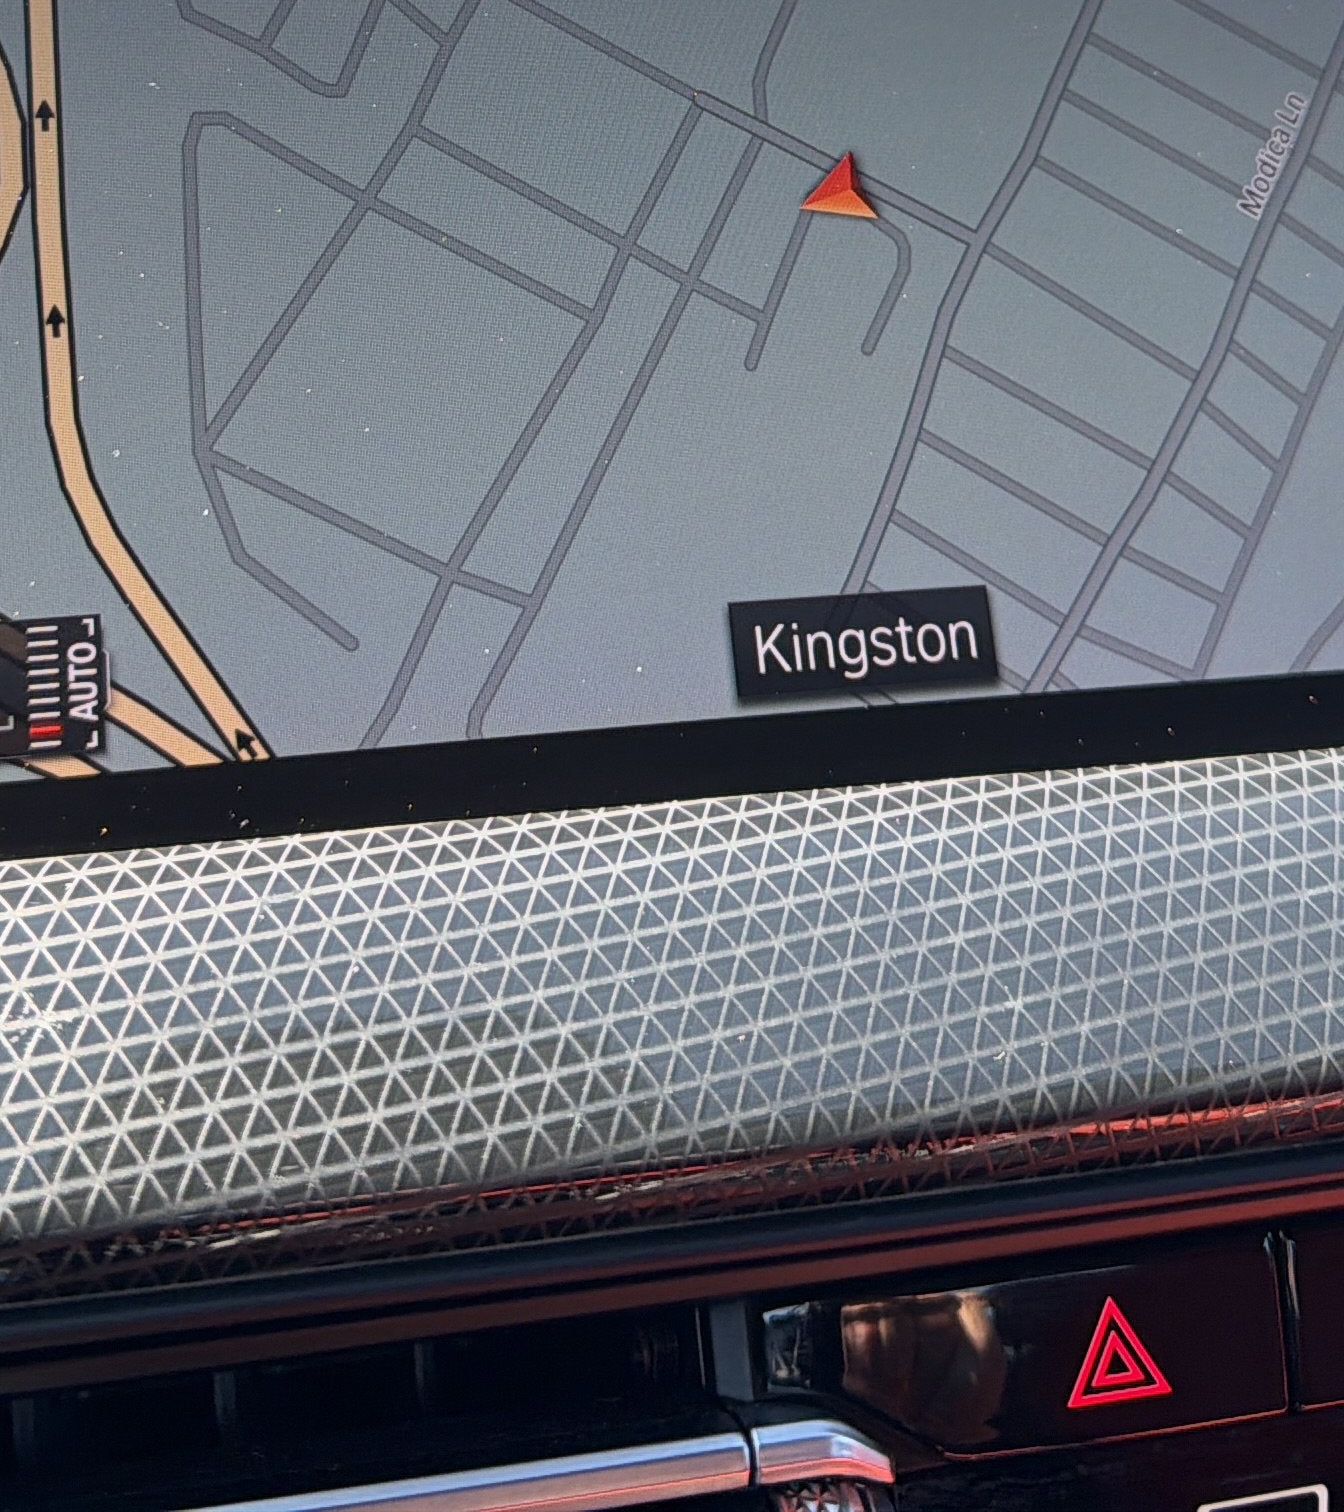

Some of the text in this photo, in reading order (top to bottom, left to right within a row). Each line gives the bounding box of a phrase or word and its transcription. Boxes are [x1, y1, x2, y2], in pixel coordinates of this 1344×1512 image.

[1238, 93, 1307, 218] Modica Ln
[66, 641, 99, 721] AUTO
[753, 617, 979, 680] Kingston
